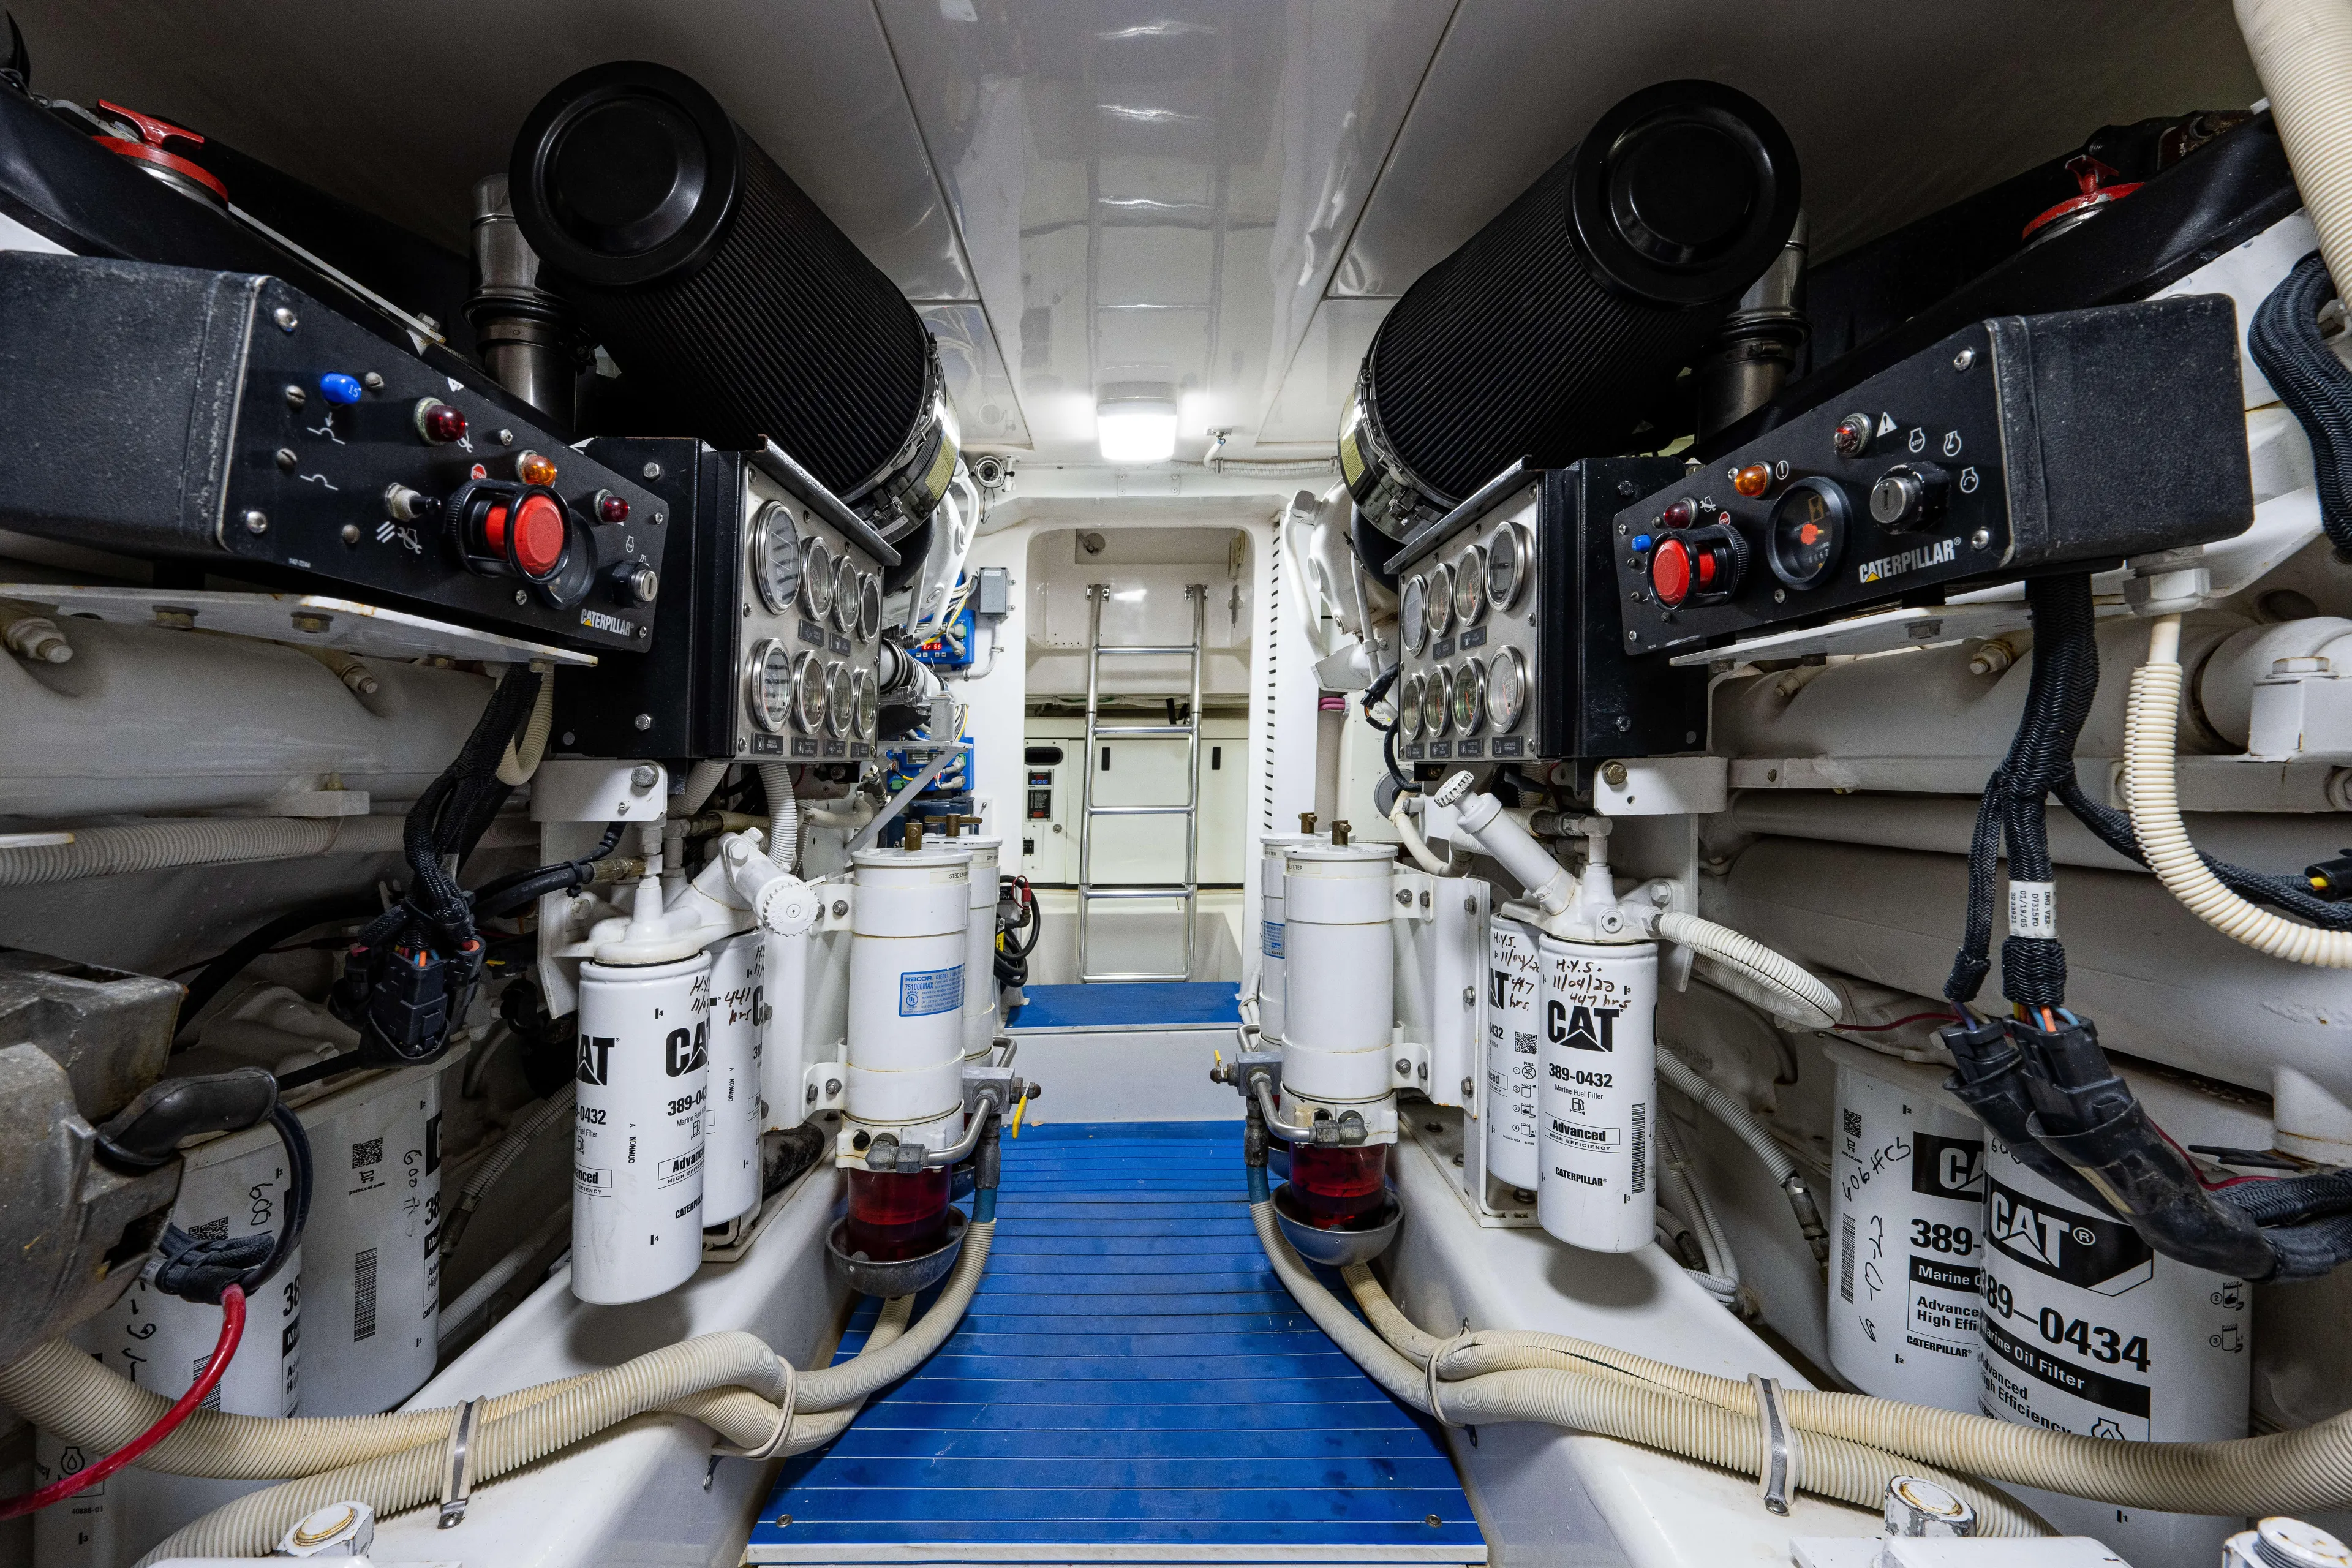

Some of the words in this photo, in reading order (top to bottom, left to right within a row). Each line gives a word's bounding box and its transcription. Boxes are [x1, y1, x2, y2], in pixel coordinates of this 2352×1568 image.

[1911, 438, 1923, 447] STOP
[473, 470, 485, 478] STOP
[905, 982, 933, 990] 751000MAX
[665, 1017, 709, 1077] CA
[576, 1033, 620, 1086] AT®
[1548, 1062, 1613, 1088] 389-0432
[668, 1085, 707, 1116] 389-043
[1555, 1084, 1572, 1095] Marine
[1574, 1089, 1586, 1098] Fuel
[1588, 1091, 1604, 1100] Filter
[575, 1102, 606, 1125] -0432
[677, 1115, 693, 1127] Marine
[1552, 1119, 1606, 1142] Advanced
[1550, 1133, 1563, 1142] HIGH
[1566, 1139, 1611, 1151] EFFICIENCY
[668, 1173, 685, 1184] HIGH
[1940, 1147, 1984, 1193] CA
[349, 1182, 385, 1196] parts.cat.com
[1910, 1218, 1982, 1256] 389-
[1918, 1264, 1970, 1286] Marine
[1917, 1295, 1979, 1317] Advance
[1917, 1309, 1950, 1328] High
[1981, 1317, 2011, 1353] Marine
[2015, 1346, 2034, 1368] Oil
[2038, 1359, 2085, 1389] Filter
[1980, 1352, 2028, 1400] Advanced
[1980, 1366, 1996, 1393] High
[72, 1506, 104, 1515] 40888-01
